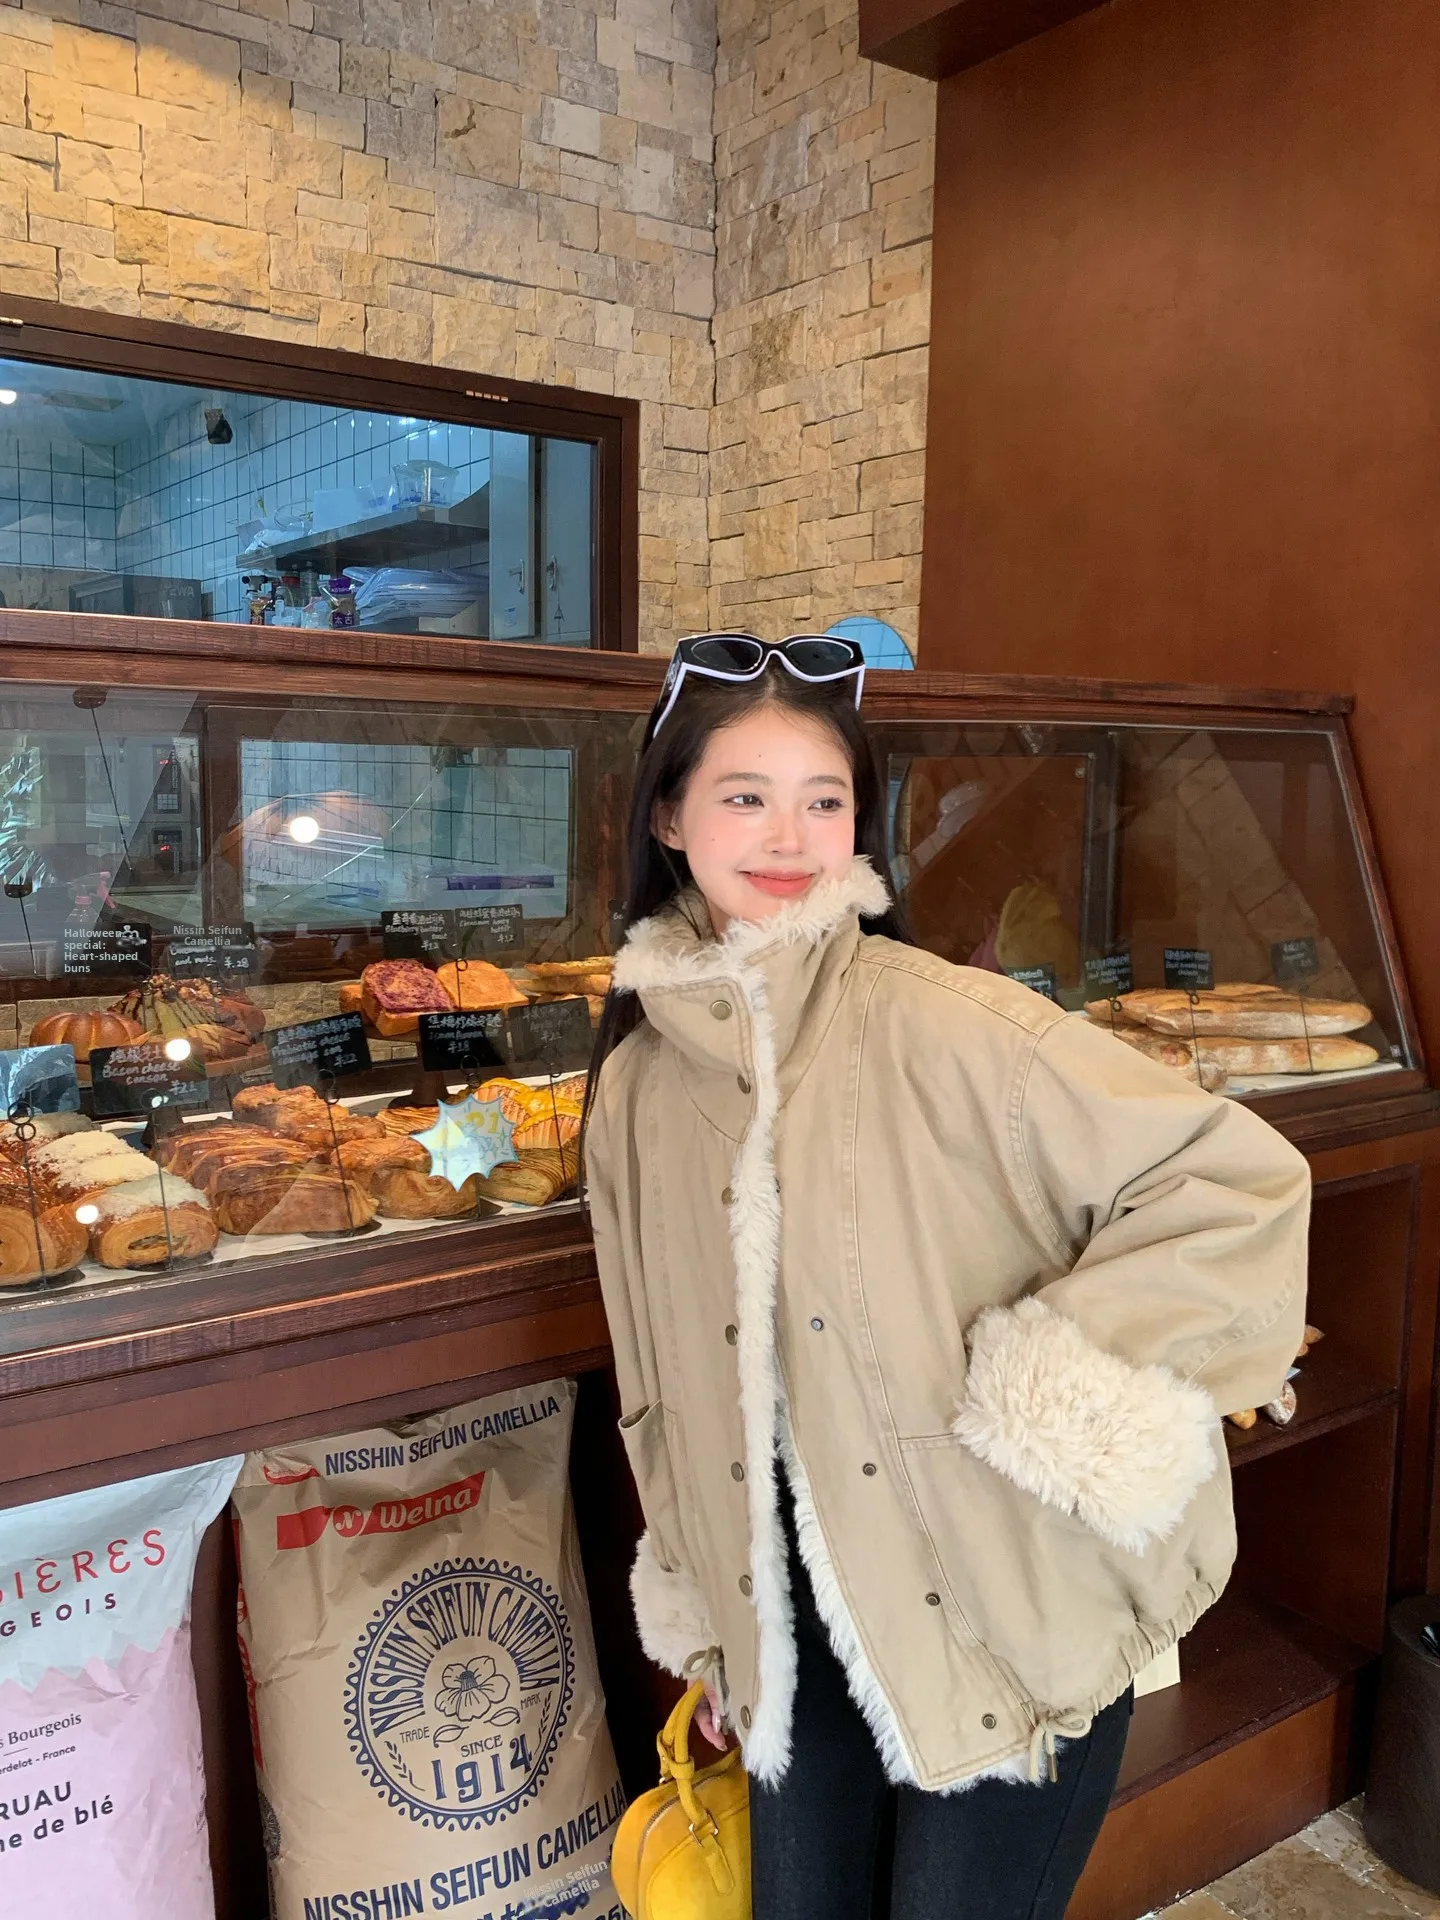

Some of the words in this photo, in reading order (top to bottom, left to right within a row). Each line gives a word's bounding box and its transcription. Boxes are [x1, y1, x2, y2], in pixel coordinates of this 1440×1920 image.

[141, 1062, 180, 1074] cheese
[325, 1445, 404, 1475] NISSHIN
[408, 1423, 468, 1463] SEIFUN
[471, 1396, 560, 1441] CAMELLIA
[380, 1487, 472, 1529] Welna
[0, 1529, 165, 1604] IÈRES
[368, 1622, 435, 1738] NISSHIN
[406, 1581, 490, 1650] SEIFUN
[488, 1586, 560, 1691] CAMELLIA
[8, 1713, 82, 1745] Bourgeois
[400, 1726, 430, 1743] TRADE
[520, 1691, 541, 1710] MARK
[42, 1745, 76, 1761] France
[431, 1733, 532, 1803] 1914
[460, 1734, 503, 1758] SINCE
[33, 1818, 64, 1840] de
[75, 1794, 113, 1825] blé
[303, 1879, 424, 1920] NISSHIN
[430, 1843, 531, 1909] SEIFUN
[537, 1780, 628, 1869] CAMELLIA
